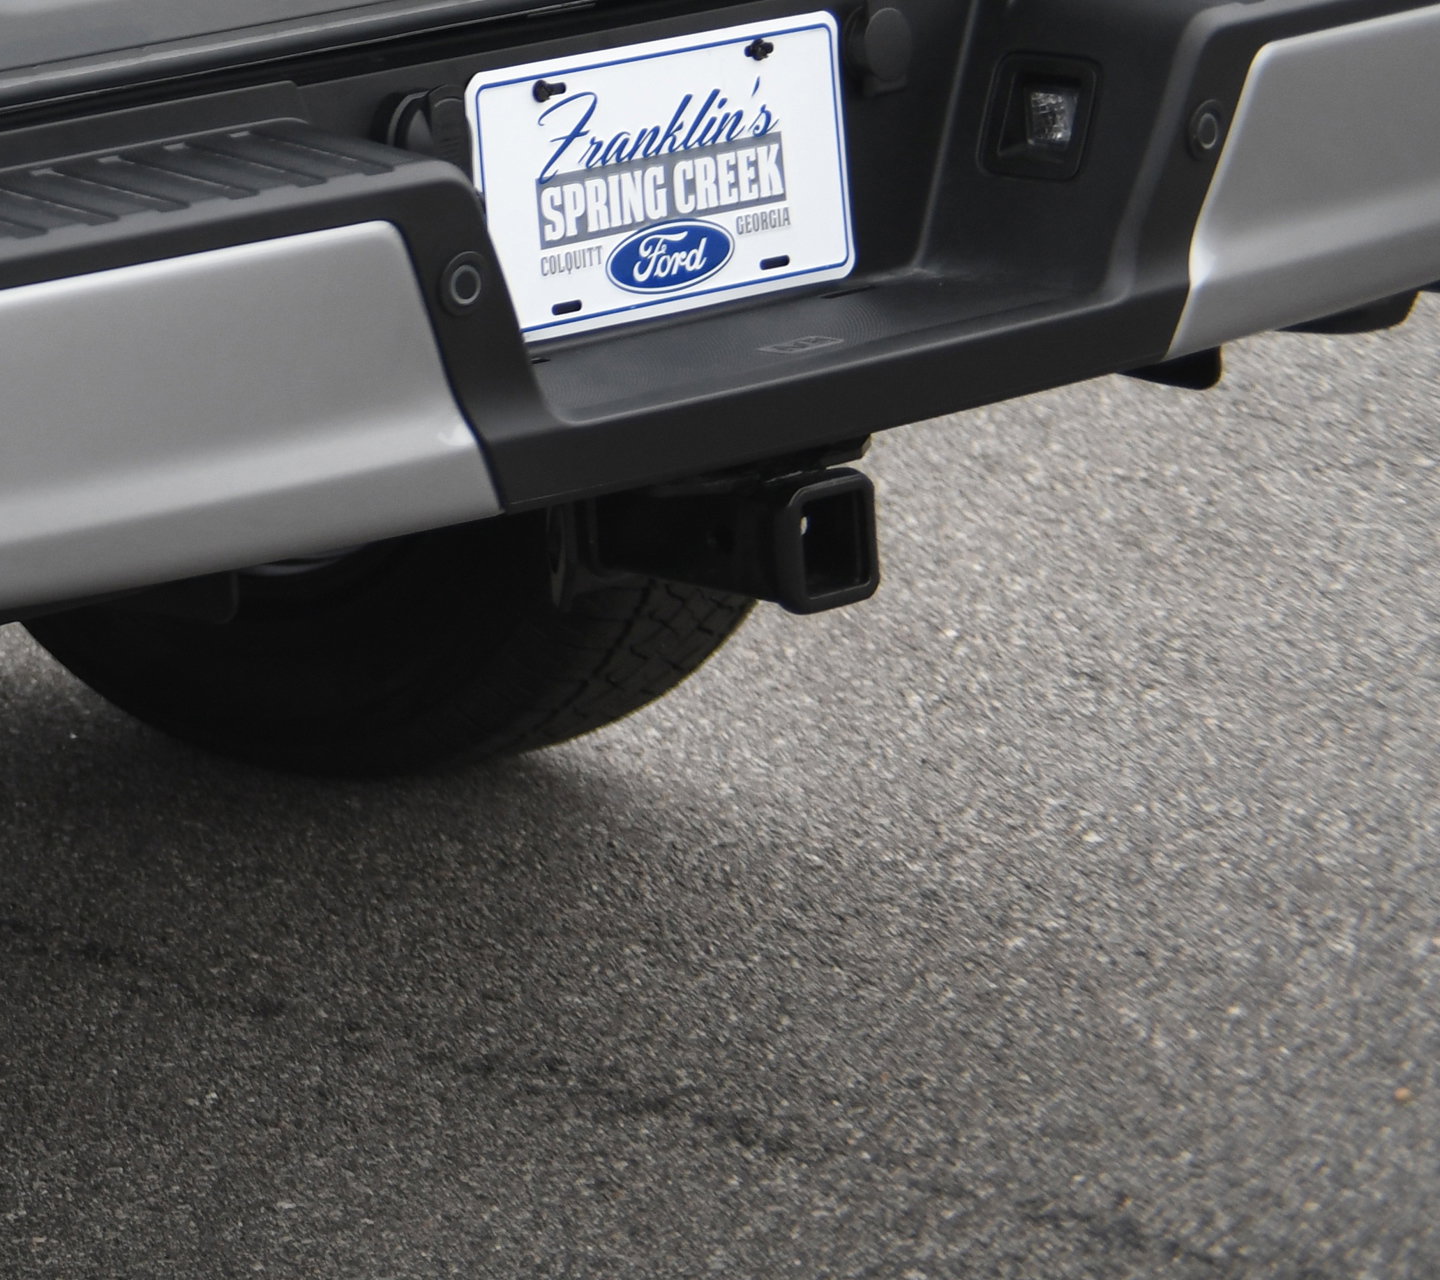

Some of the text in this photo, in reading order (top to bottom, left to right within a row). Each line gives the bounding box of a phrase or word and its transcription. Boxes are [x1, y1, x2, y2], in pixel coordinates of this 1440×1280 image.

[536, 76, 780, 185] Franklin's
[540, 142, 784, 243] SPRING CREEK
[735, 206, 792, 237] GEORGIA
[540, 245, 604, 278] COLQUITT
[632, 230, 709, 283] Ford
